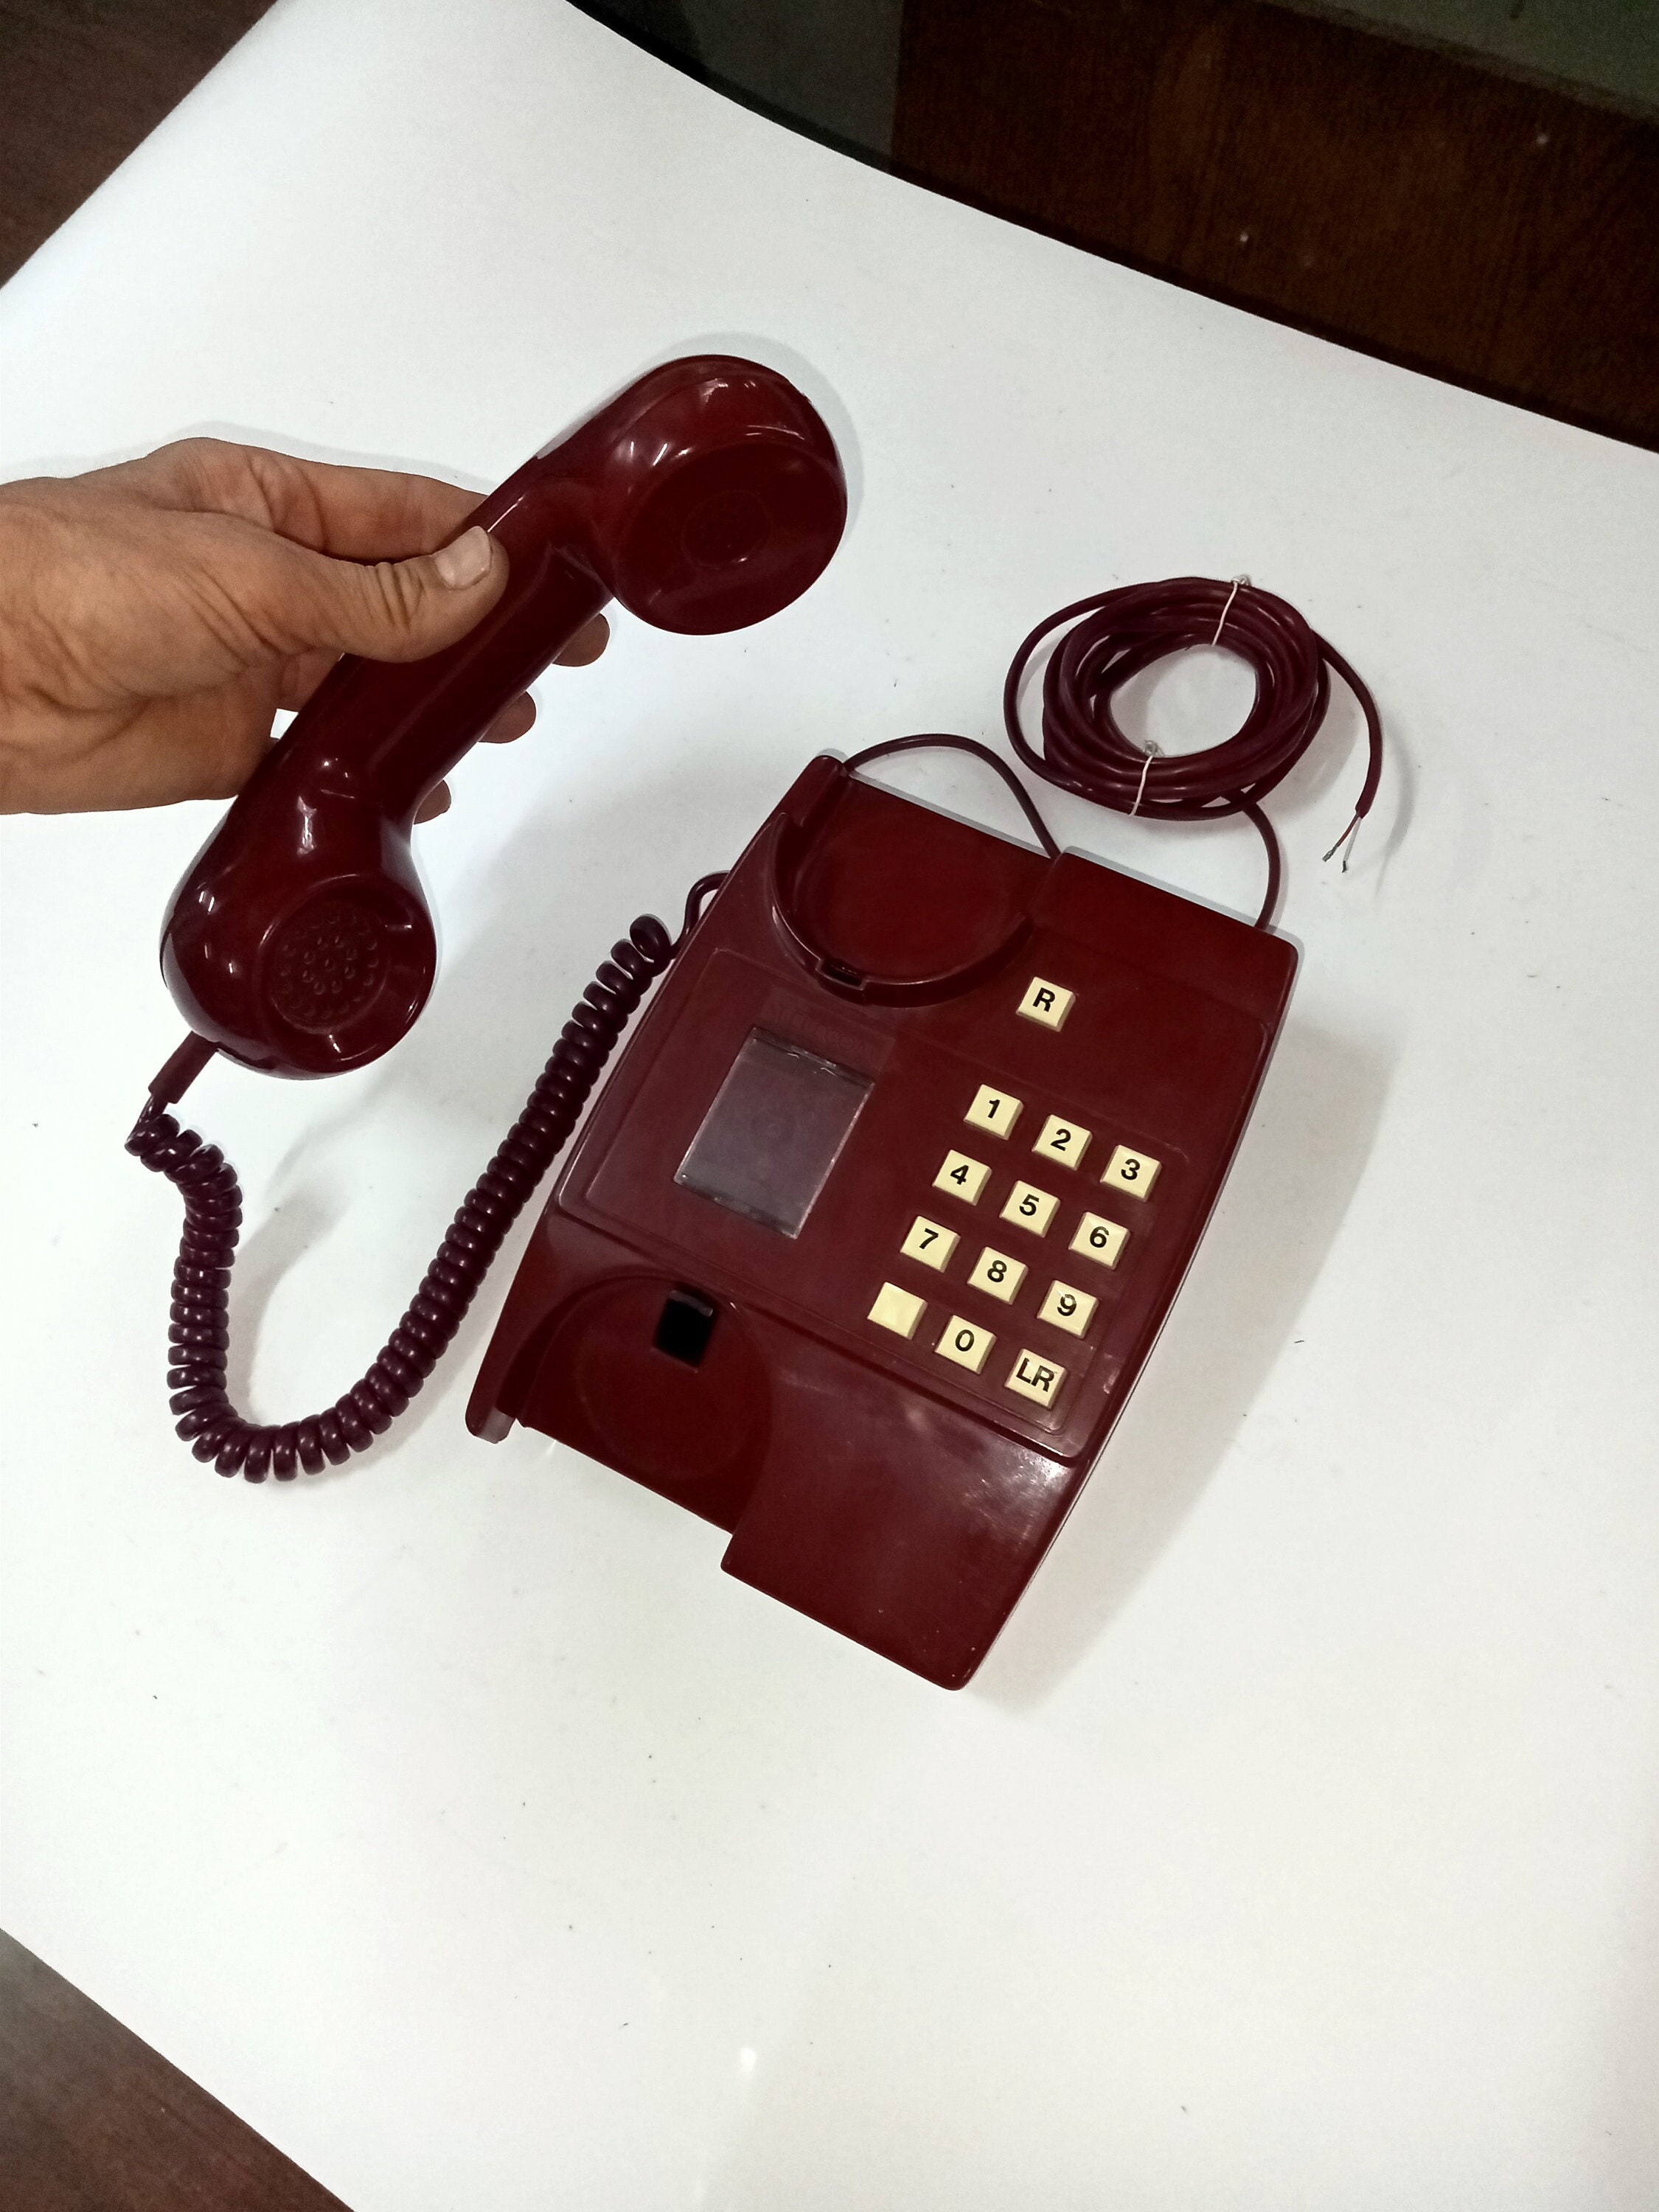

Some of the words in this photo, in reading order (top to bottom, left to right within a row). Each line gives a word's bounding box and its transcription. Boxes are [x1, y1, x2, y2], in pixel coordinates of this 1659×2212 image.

[1032, 987, 1056, 1012] R
[987, 1099, 1001, 1119] 1
[1050, 1128, 1071, 1152] 2
[950, 1164, 969, 1186] 4
[1121, 1158, 1141, 1180] 3
[1019, 1194, 1040, 1217] 5
[919, 1228, 939, 1250] 7
[1089, 1226, 1110, 1248] 6
[987, 1260, 1007, 1283] 8
[1057, 1294, 1077, 1317] 9
[955, 1329, 975, 1352] 0
[1015, 1357, 1054, 1392] LR
